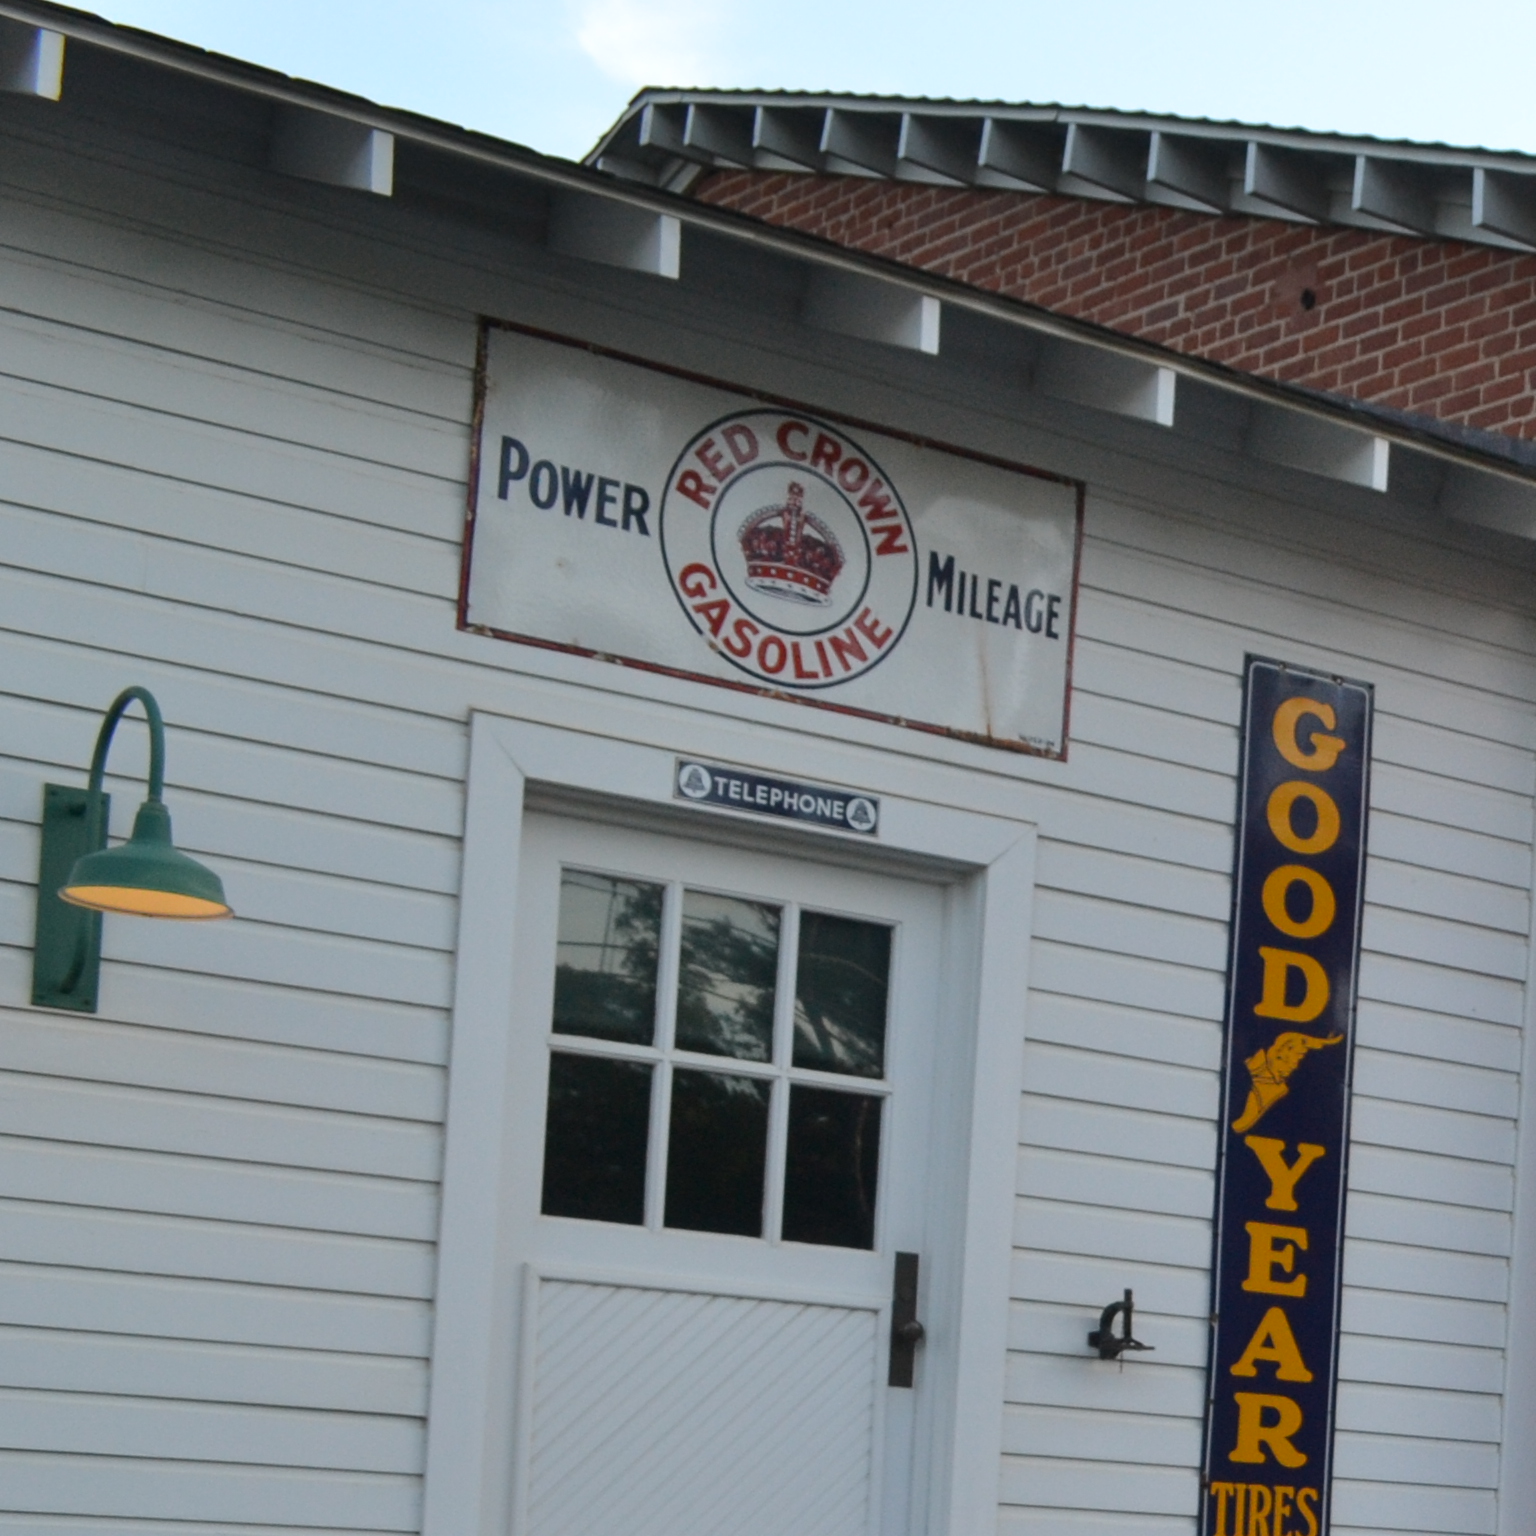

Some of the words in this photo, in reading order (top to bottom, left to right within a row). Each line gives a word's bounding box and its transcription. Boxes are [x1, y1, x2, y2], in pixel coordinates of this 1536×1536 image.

[497, 436, 651, 538] POWER
[675, 421, 761, 511] RED
[775, 419, 909, 557] CROWN
[678, 561, 894, 680] GASOLINE
[926, 550, 1062, 640] MILEAGE
[713, 775, 846, 822] TELEPHONE
